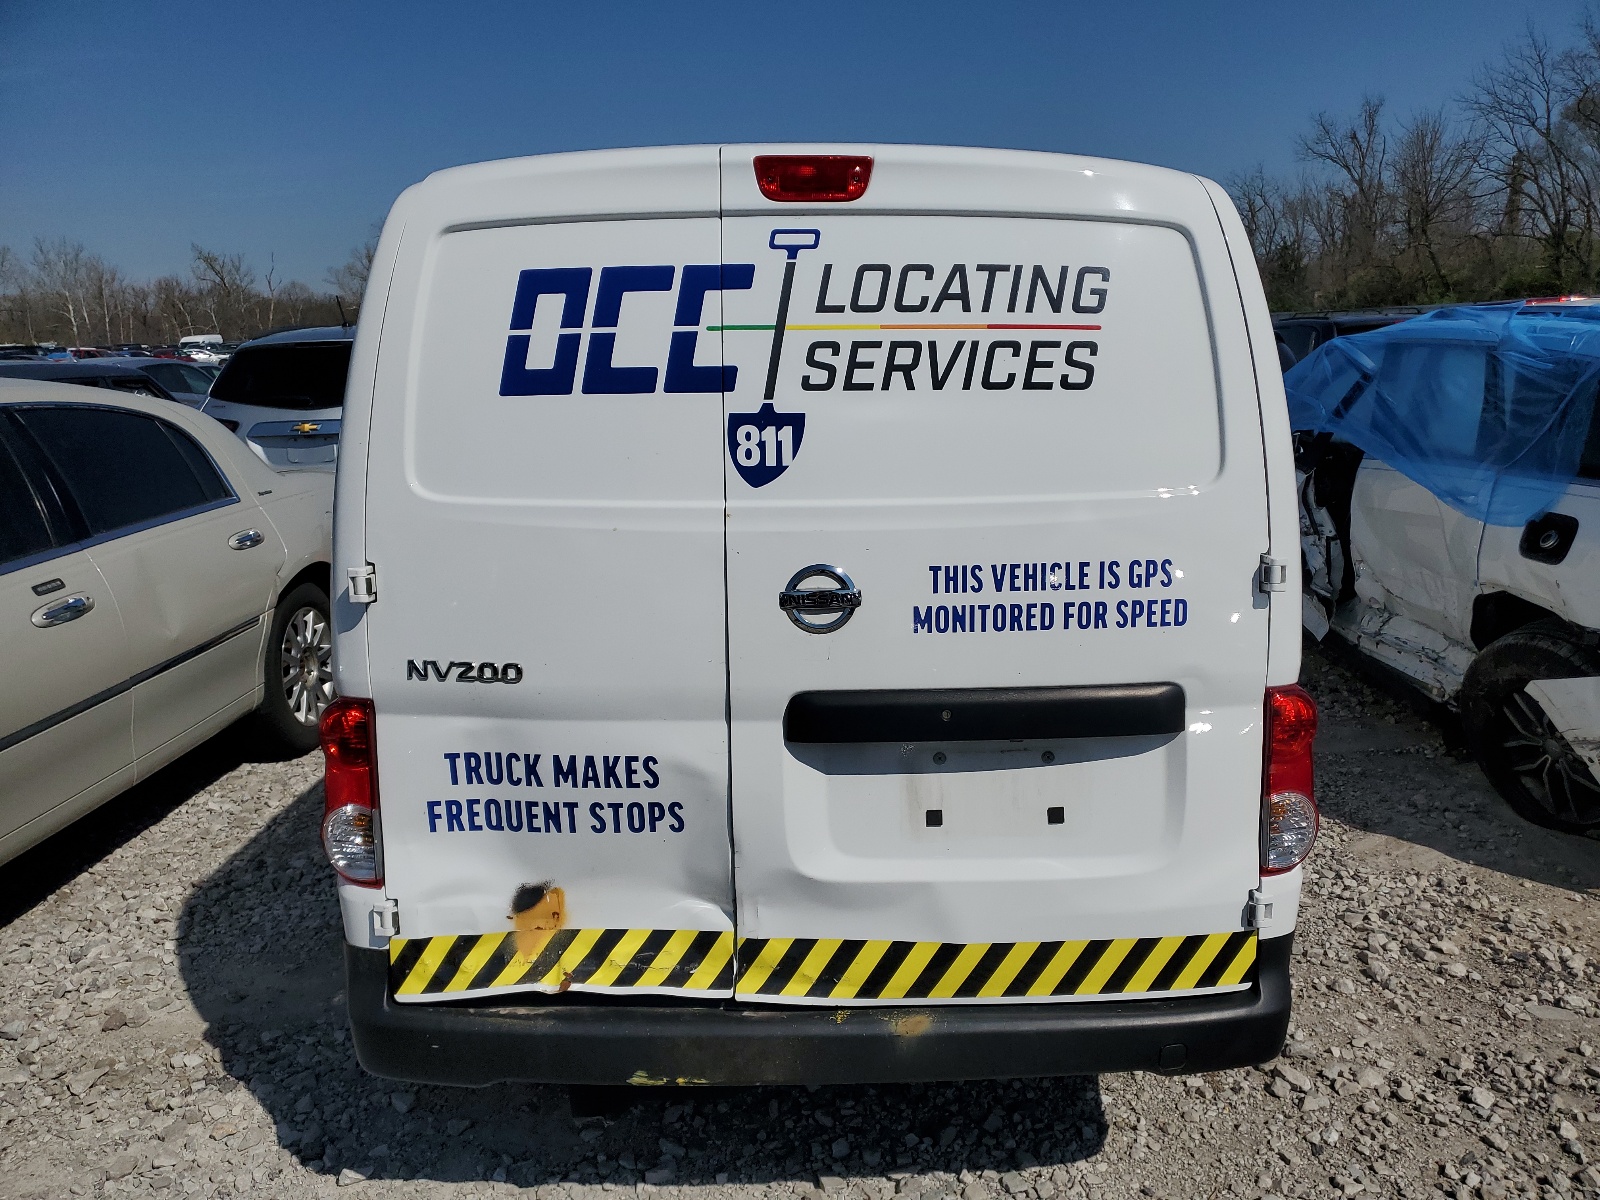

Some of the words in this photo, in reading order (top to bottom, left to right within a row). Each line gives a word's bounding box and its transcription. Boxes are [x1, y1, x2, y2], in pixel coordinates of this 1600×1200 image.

[814, 263, 1111, 315] LOCATING
[499, 263, 756, 397] OCC
[800, 339, 1099, 392] SERVICES
[735, 424, 794, 468] 811
[929, 565, 983, 594] THIS
[991, 561, 1090, 592] VEHICLE
[1099, 560, 1121, 589] IS
[1128, 558, 1174, 588] GPS
[913, 602, 1056, 634] MONITORED
[1063, 601, 1108, 630] FOR
[1115, 598, 1190, 628] SPEED
[407, 659, 523, 684] NV200
[444, 752, 544, 787] TRUCK
[552, 754, 660, 789] MAKES
[426, 798, 579, 833] FREQUENT
[588, 801, 686, 834] STOPS
